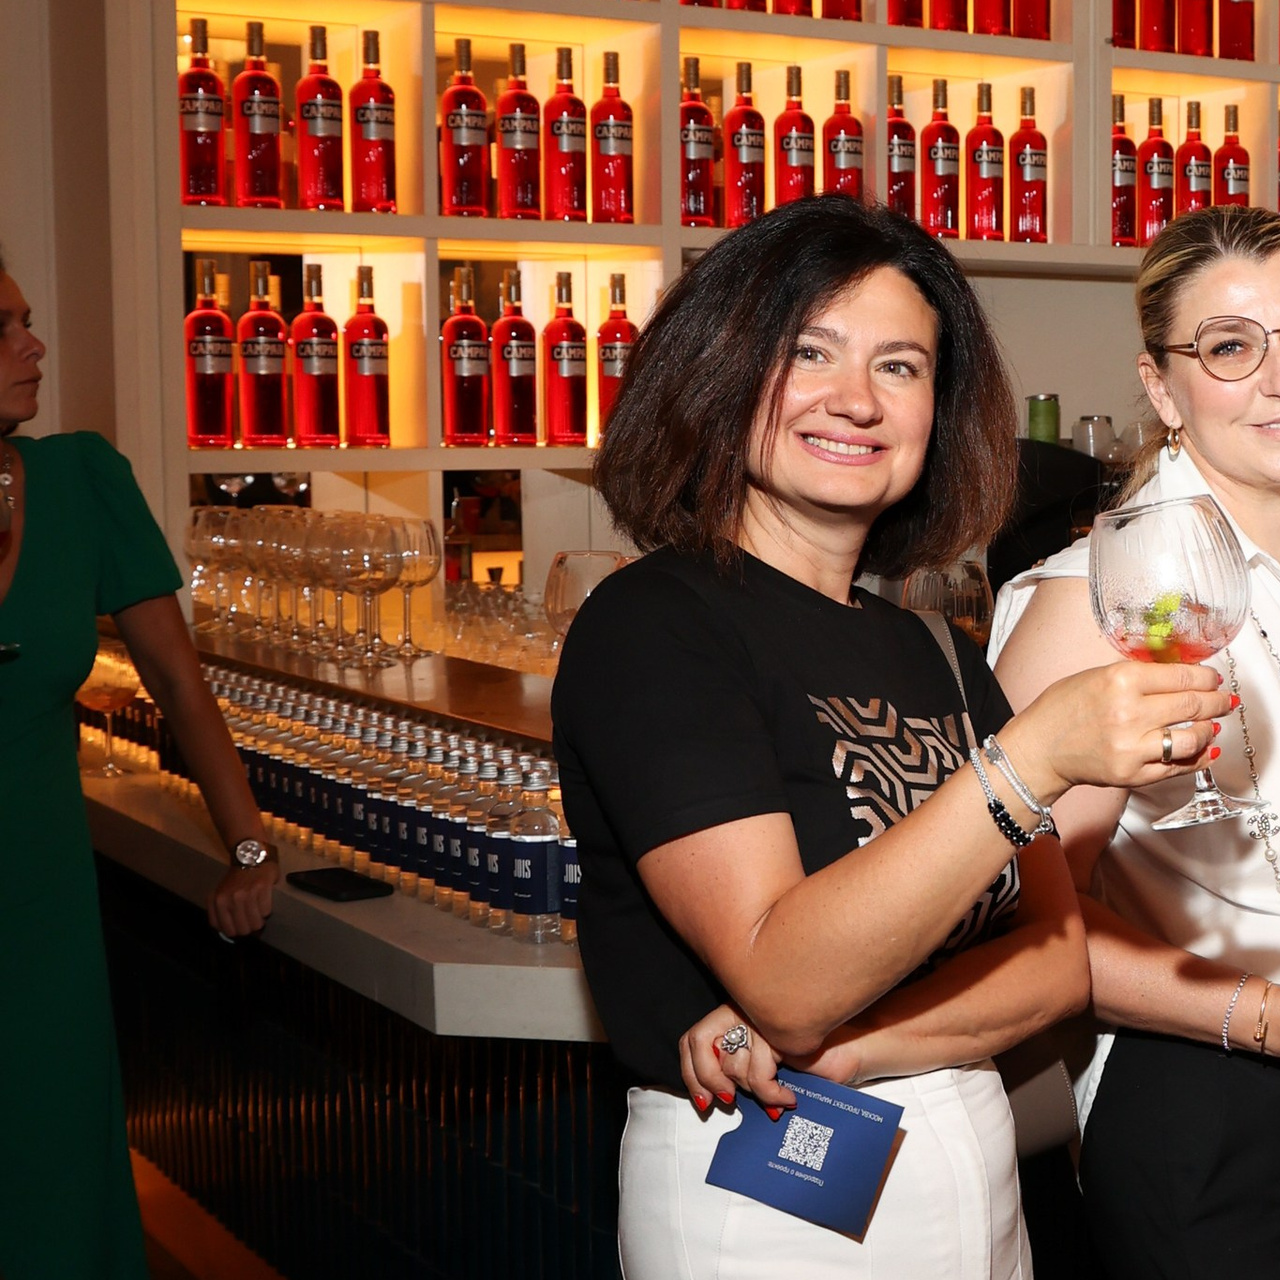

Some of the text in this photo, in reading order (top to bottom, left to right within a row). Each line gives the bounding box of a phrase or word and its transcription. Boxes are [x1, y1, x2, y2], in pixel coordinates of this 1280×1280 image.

[514, 858, 532, 879] JOIS
[804, 1089, 832, 1104] МАРШАЛА
[832, 1098, 860, 1115] ПРОСПЕКТ
